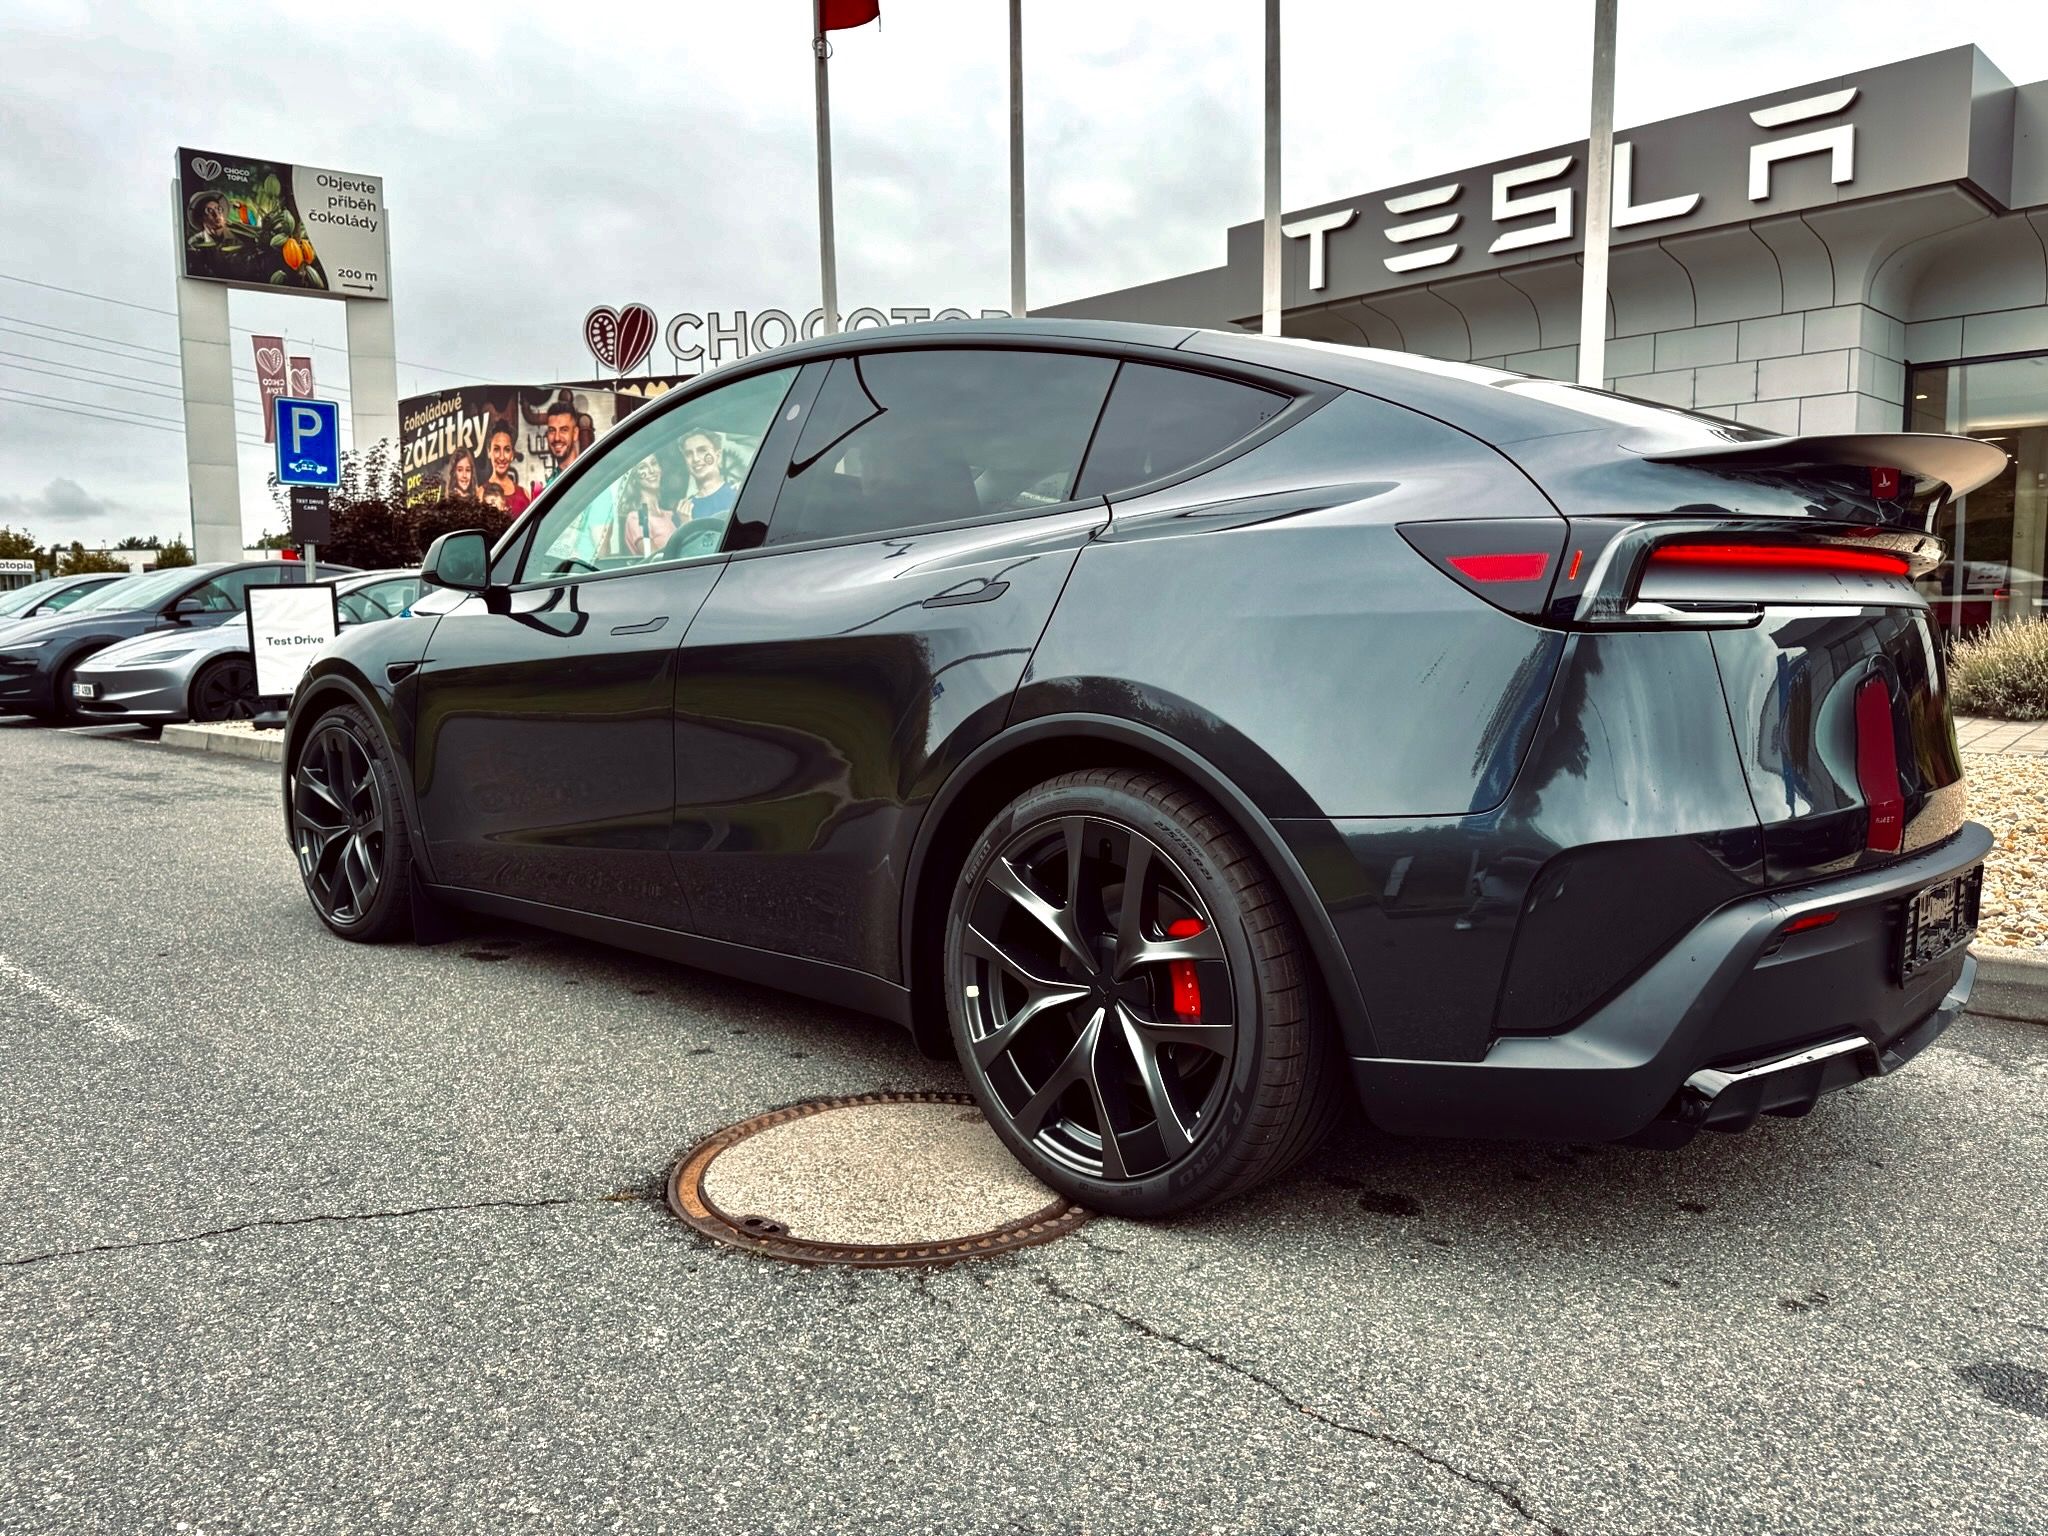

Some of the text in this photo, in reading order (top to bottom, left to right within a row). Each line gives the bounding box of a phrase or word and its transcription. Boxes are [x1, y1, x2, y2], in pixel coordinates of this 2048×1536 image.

[223, 167, 250, 177] CHOCO
[226, 174, 249, 183] TOPIA
[316, 174, 376, 194] Objevte
[1281, 86, 1860, 291] TESLA
[328, 193, 376, 212] příběh
[309, 209, 378, 232] čokolády
[337, 268, 377, 281] 200 m
[404, 392, 462, 432] čokoládové
[291, 407, 323, 454] P
[403, 410, 490, 474] zážitky
[309, 498, 324, 506] DRIVE
[266, 635, 324, 646] Test Drive
[1180, 1124, 1231, 1185] ZERO
